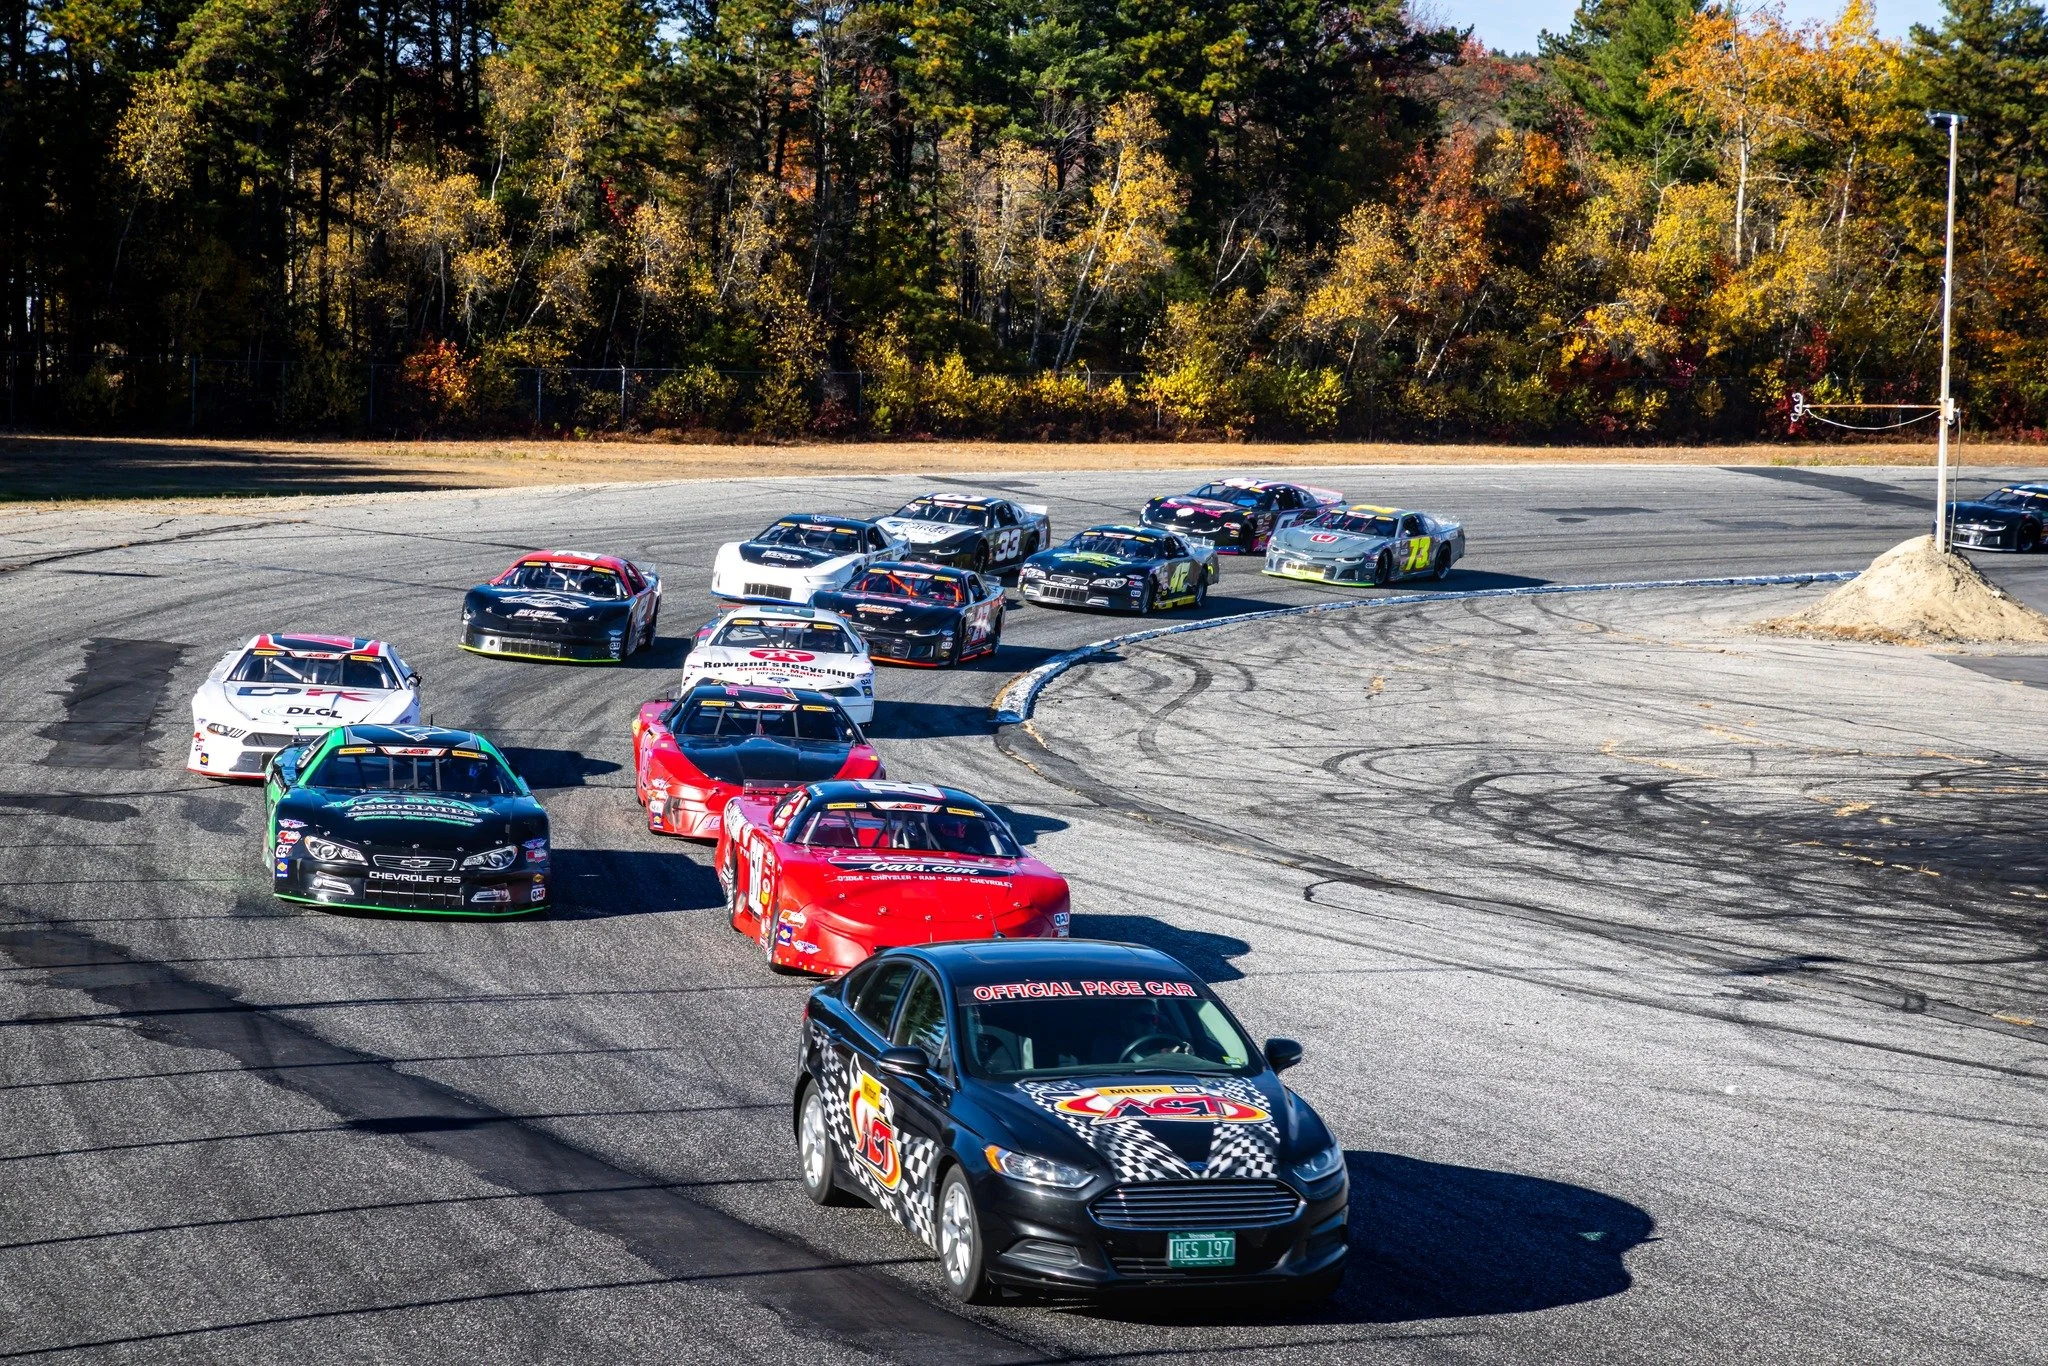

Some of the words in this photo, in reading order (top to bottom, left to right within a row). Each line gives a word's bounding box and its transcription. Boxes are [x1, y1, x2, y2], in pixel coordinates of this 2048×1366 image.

[995, 529, 1021, 561] 33
[704, 660, 780, 669] Rowland's
[781, 662, 856, 679] Recycling
[790, 669, 823, 677] Maine
[287, 706, 343, 718] DLGL
[348, 803, 476, 817] ASSOCIATES
[868, 862, 980, 875] Cars.com
[368, 871, 443, 883] CHEVROLET
[443, 876, 461, 884] SS
[970, 877, 1012, 888] CHEVROLET
[973, 981, 1083, 1001] OFFICIAL
[1081, 980, 1146, 996] PACE
[1144, 981, 1198, 997] CAR
[1109, 1086, 1163, 1095] Milton
[1103, 1095, 1224, 1120] ACT
[1175, 1240, 1199, 1259] HES
[1206, 1240, 1230, 1258] 197
